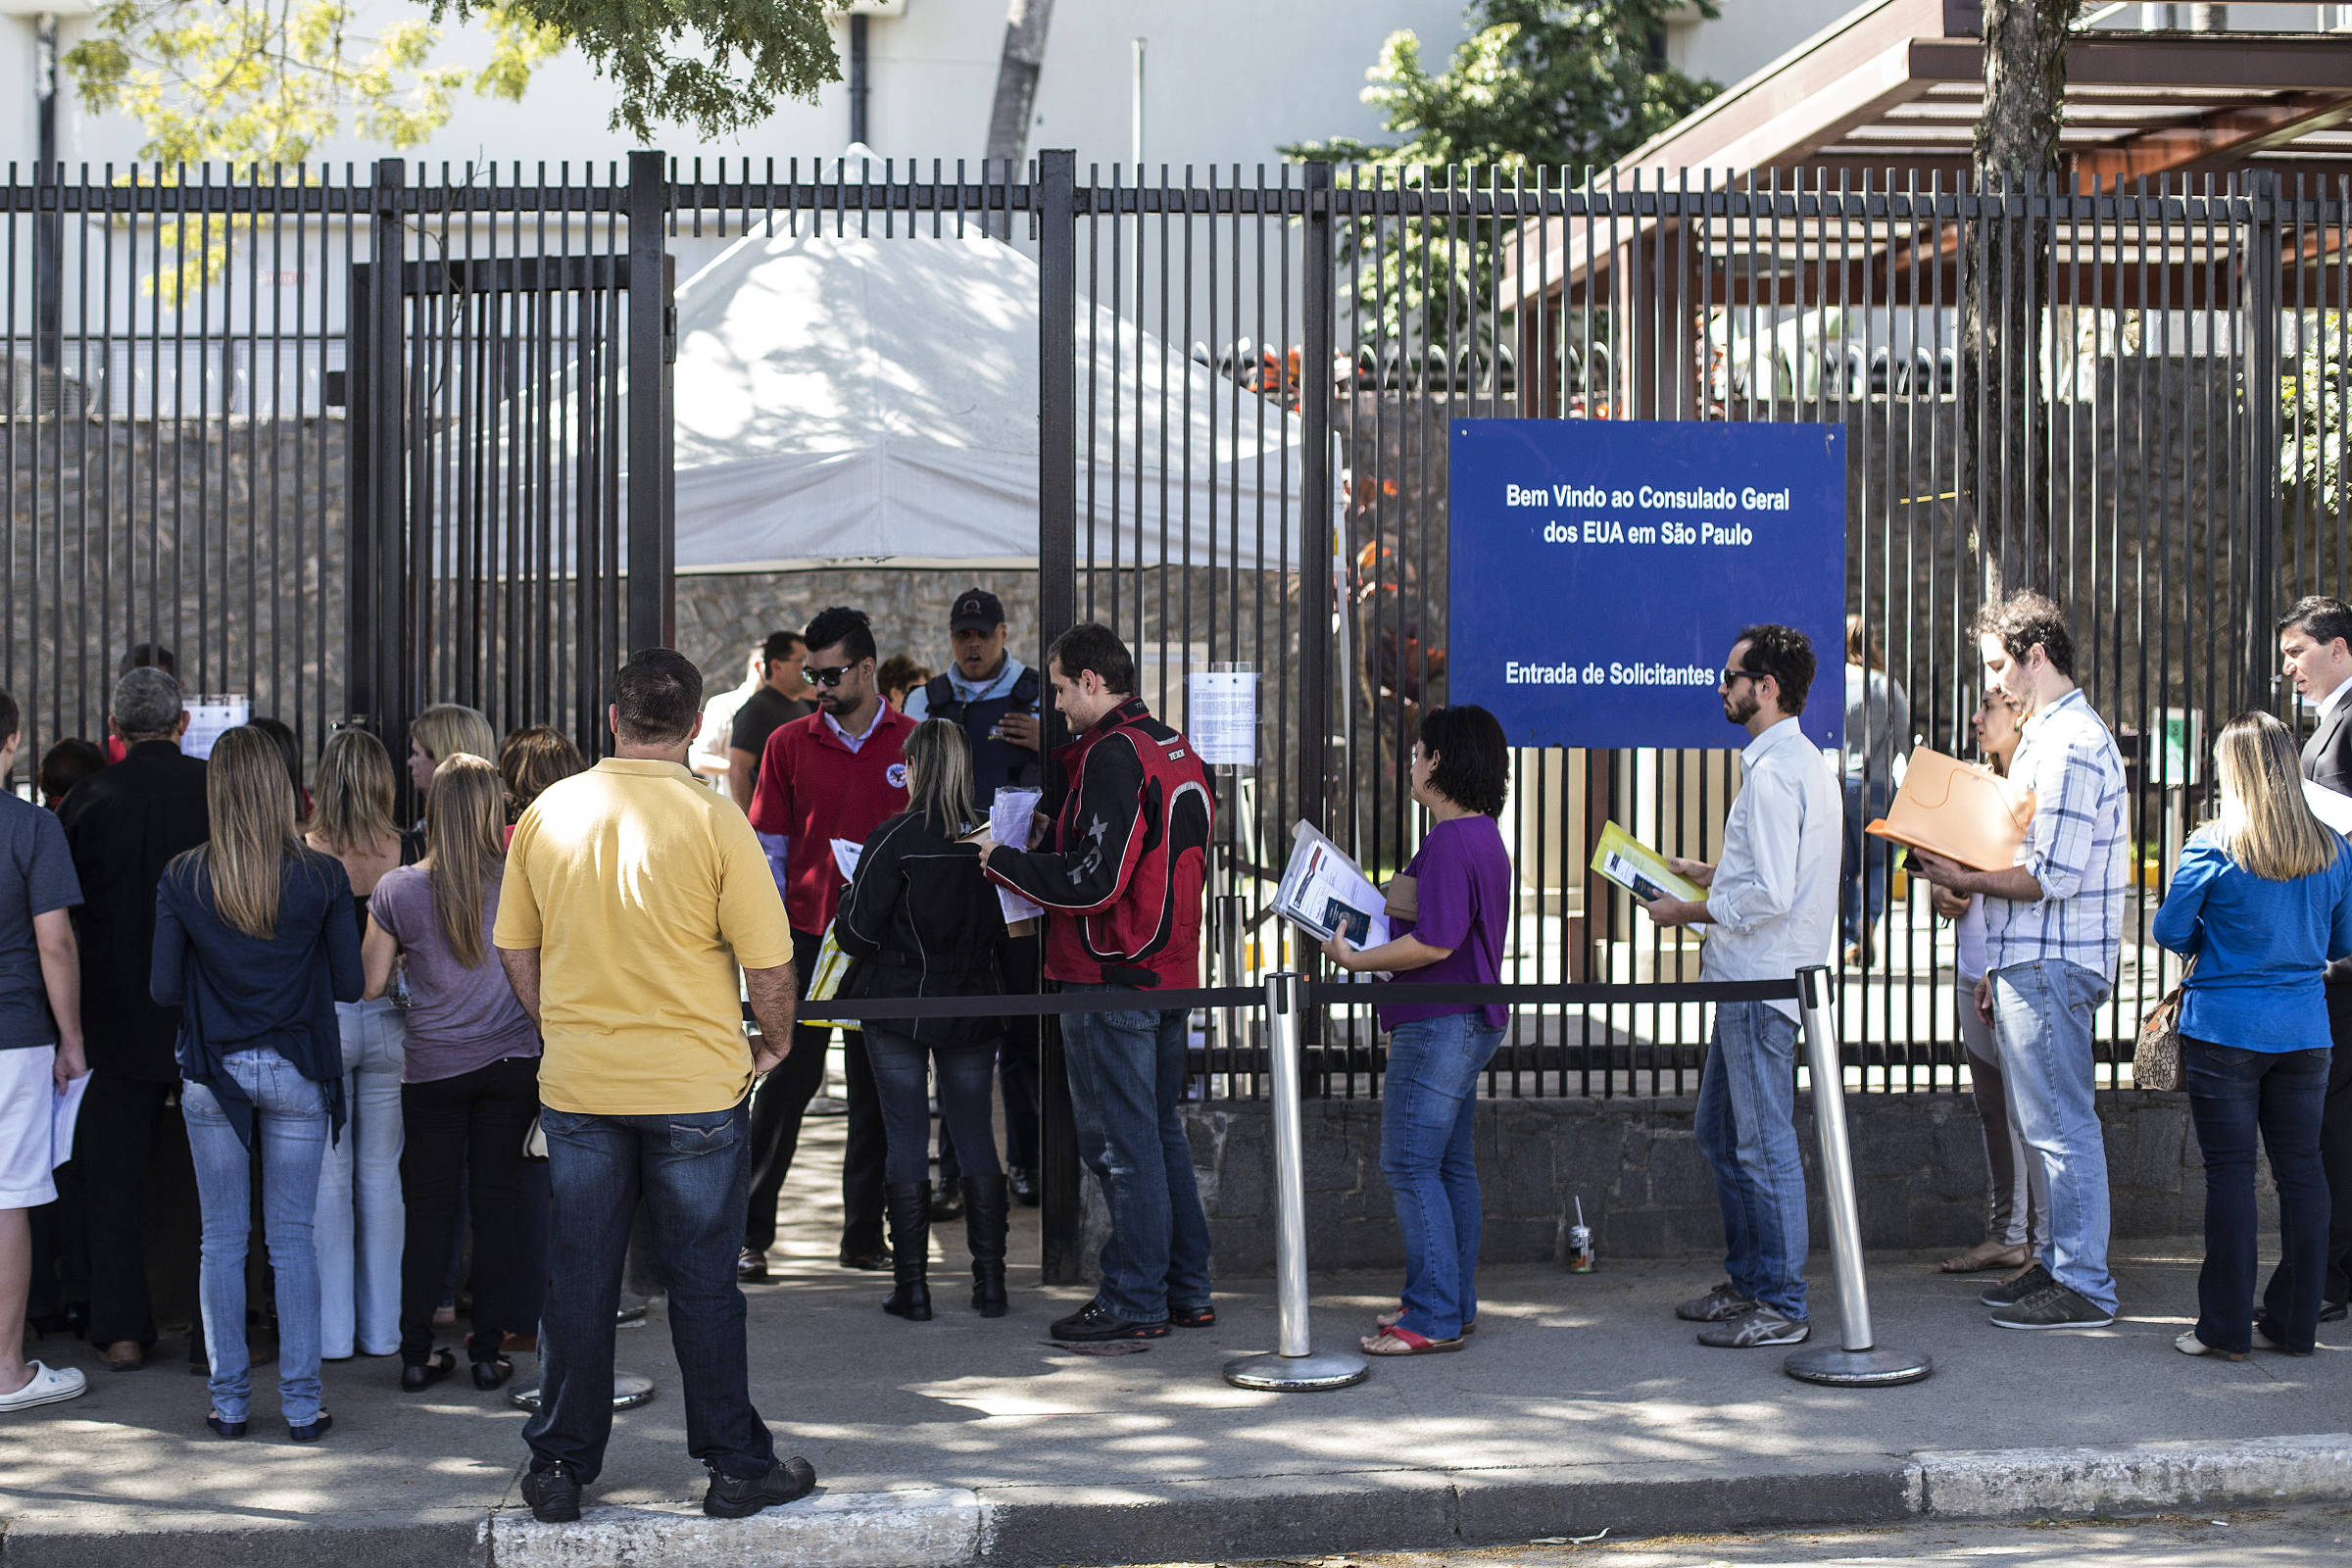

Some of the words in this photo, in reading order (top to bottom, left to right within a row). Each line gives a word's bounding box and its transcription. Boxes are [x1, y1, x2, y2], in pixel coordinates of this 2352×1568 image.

[1506, 484, 1548, 507] Bem
[1552, 484, 1607, 508] Vindo
[1611, 490, 1635, 509] ao
[1639, 486, 1738, 511] Consulado
[1740, 487, 1789, 511] Geral
[1544, 520, 1579, 544] dos
[1583, 520, 1625, 544] EUA
[1628, 525, 1656, 544] em
[1660, 520, 1697, 545] São
[1701, 522, 1753, 546] Paulo
[1505, 662, 1578, 685] Entrada
[1582, 662, 1605, 685] de
[1609, 662, 1715, 686] Solicitantes
